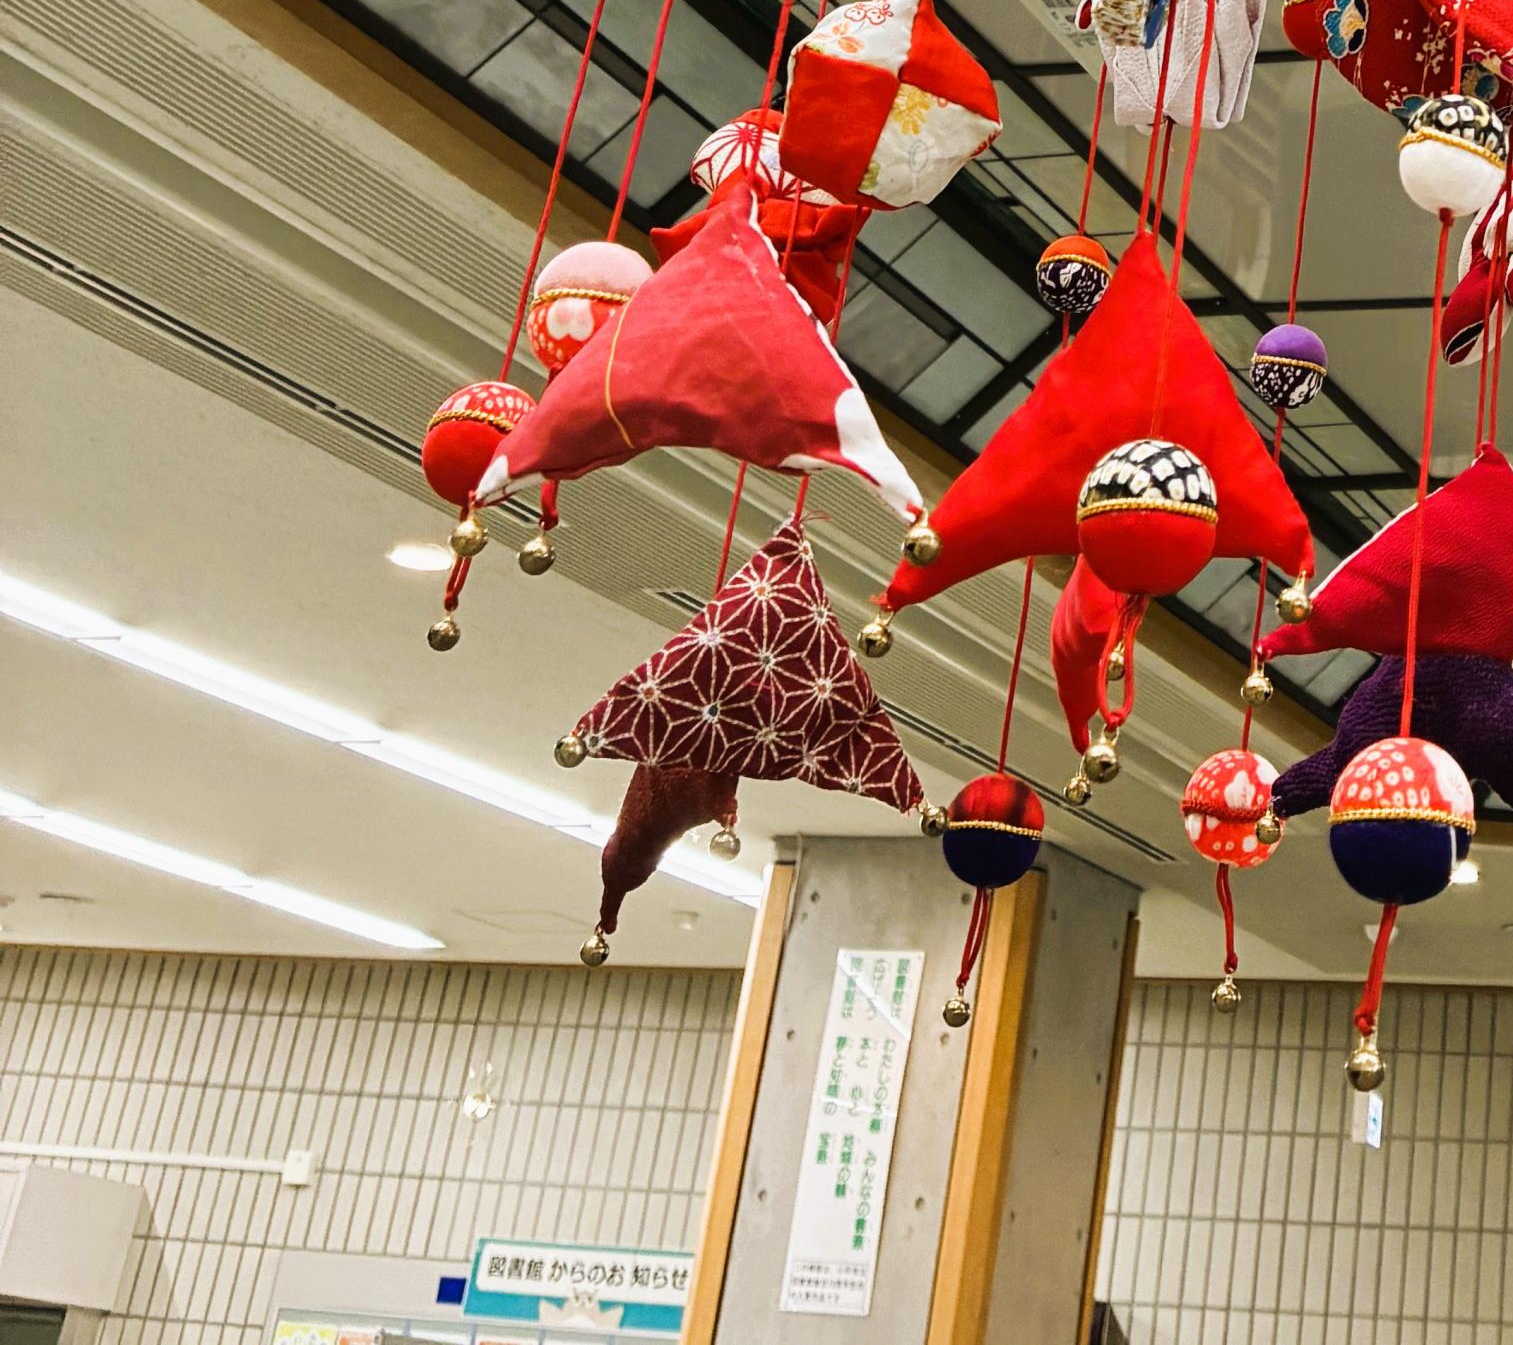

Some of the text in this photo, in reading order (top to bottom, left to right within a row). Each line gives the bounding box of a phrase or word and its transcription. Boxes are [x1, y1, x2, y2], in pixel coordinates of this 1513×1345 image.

[489, 1255, 688, 1290] 図書館からのお知らせ
